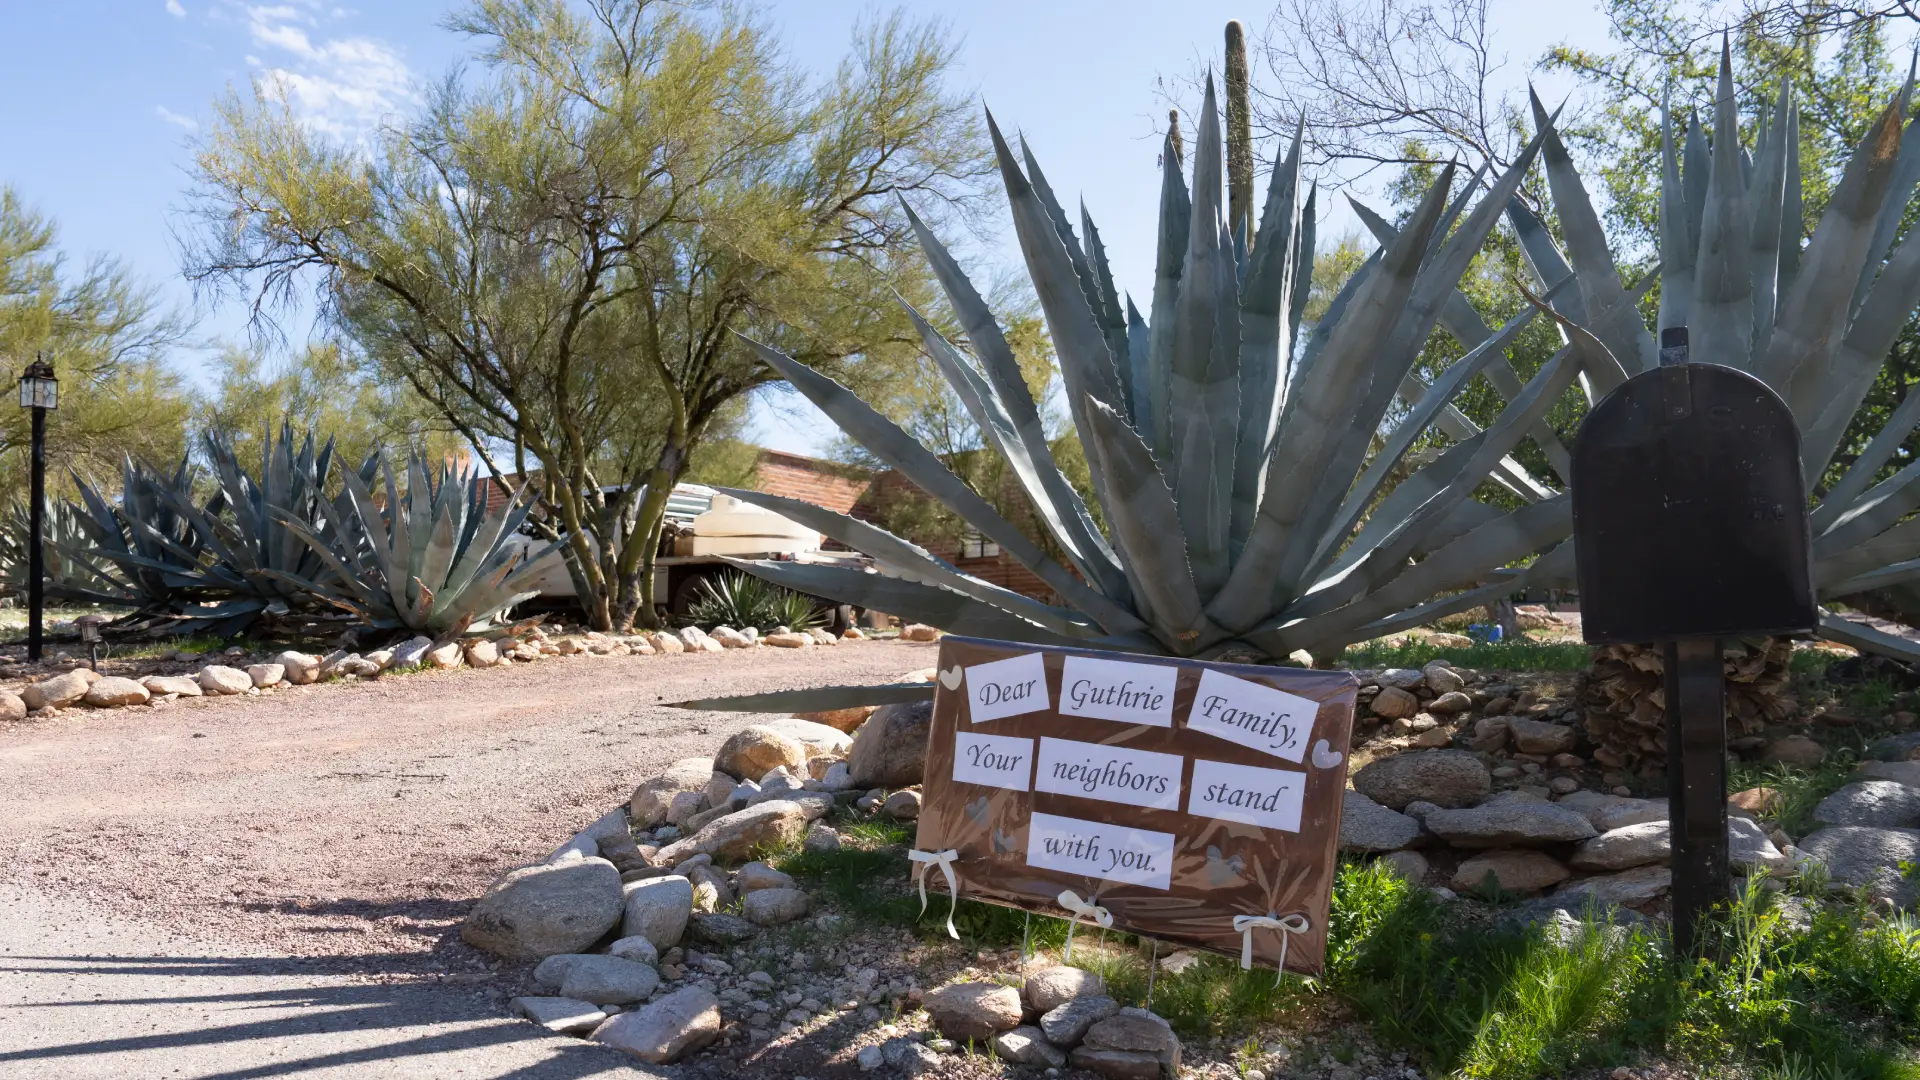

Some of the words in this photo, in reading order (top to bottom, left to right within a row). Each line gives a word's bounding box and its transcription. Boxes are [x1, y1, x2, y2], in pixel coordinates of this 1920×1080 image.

[979, 680, 1037, 706] Dear
[1070, 680, 1165, 711] Guthrie
[1202, 695, 1297, 749] Family,
[967, 744, 1023, 772] Your
[1052, 758, 1169, 794] neighbors
[1202, 784, 1289, 813] stand
[1044, 834, 1102, 861] with
[1101, 848, 1157, 873] you.
